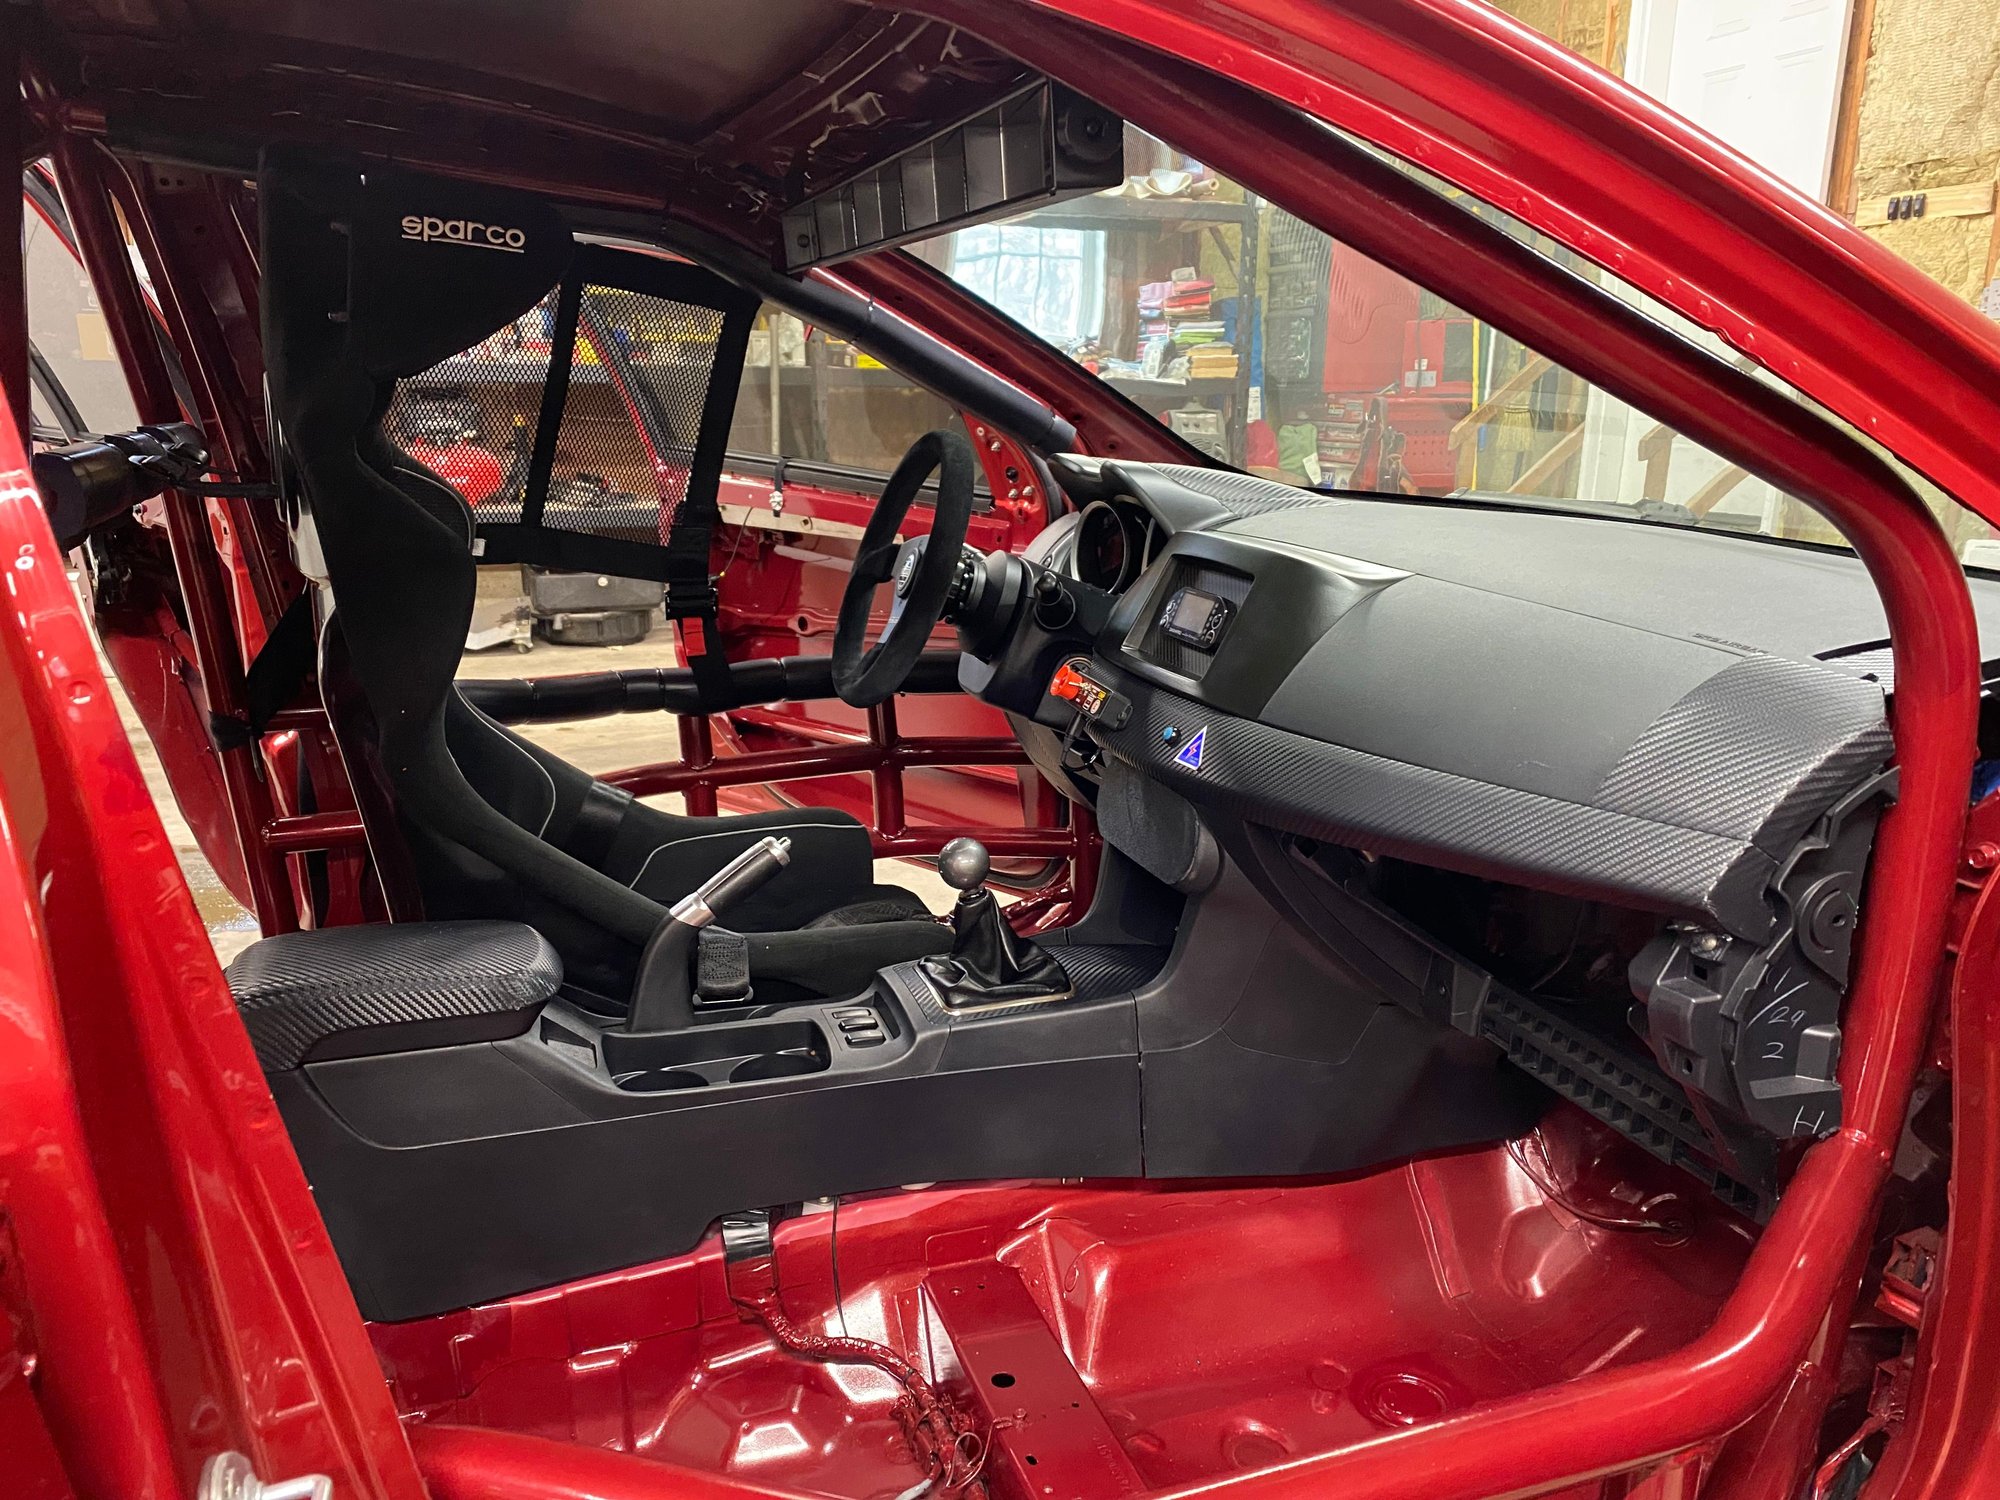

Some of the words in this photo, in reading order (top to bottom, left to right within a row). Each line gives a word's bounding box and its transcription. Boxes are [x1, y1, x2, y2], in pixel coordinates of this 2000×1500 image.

[401, 215, 526, 248] sparco
[1761, 1041, 1784, 1059] 2
[1792, 1105, 1825, 1135] H
